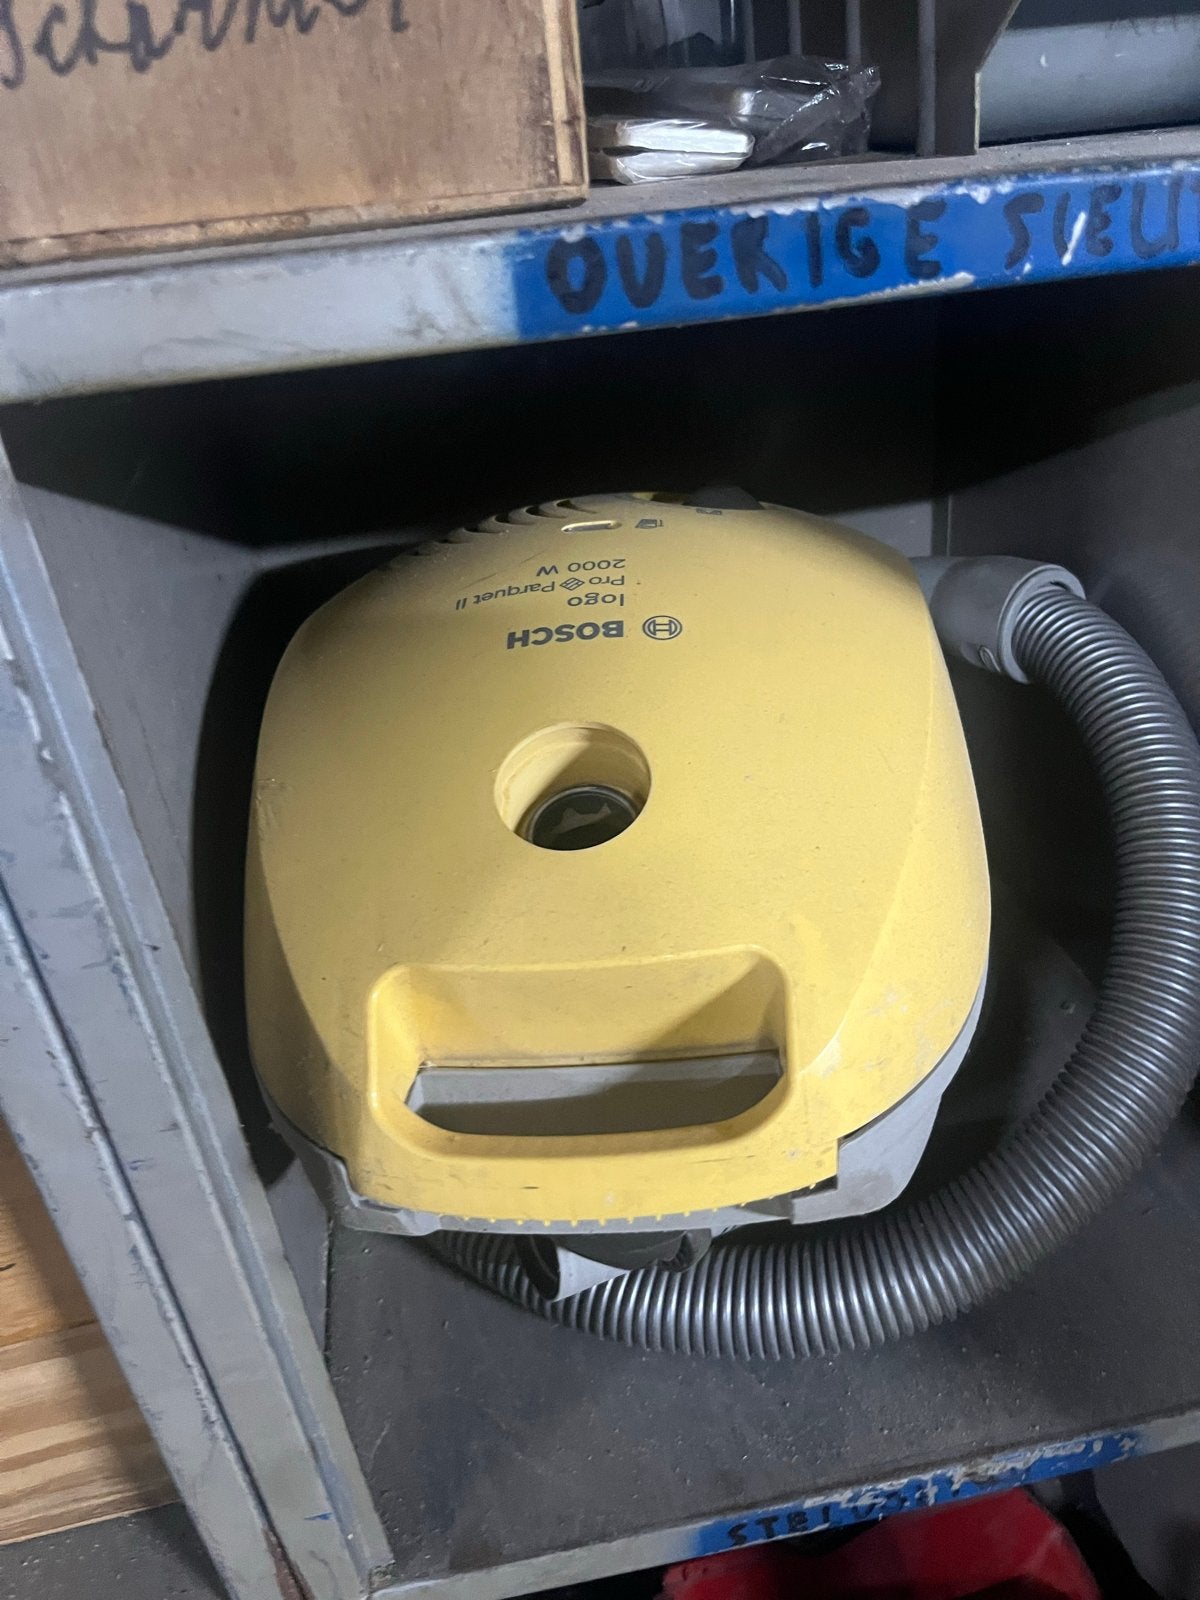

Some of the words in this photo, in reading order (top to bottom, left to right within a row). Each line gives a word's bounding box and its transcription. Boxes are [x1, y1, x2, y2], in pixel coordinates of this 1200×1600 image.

[535, 564, 559, 577] W
[567, 558, 627, 573] 2000
[588, 575, 626, 586] Pro
[472, 581, 556, 605] Parquet
[566, 592, 625, 607] logo
[506, 620, 625, 650] BOSCH
